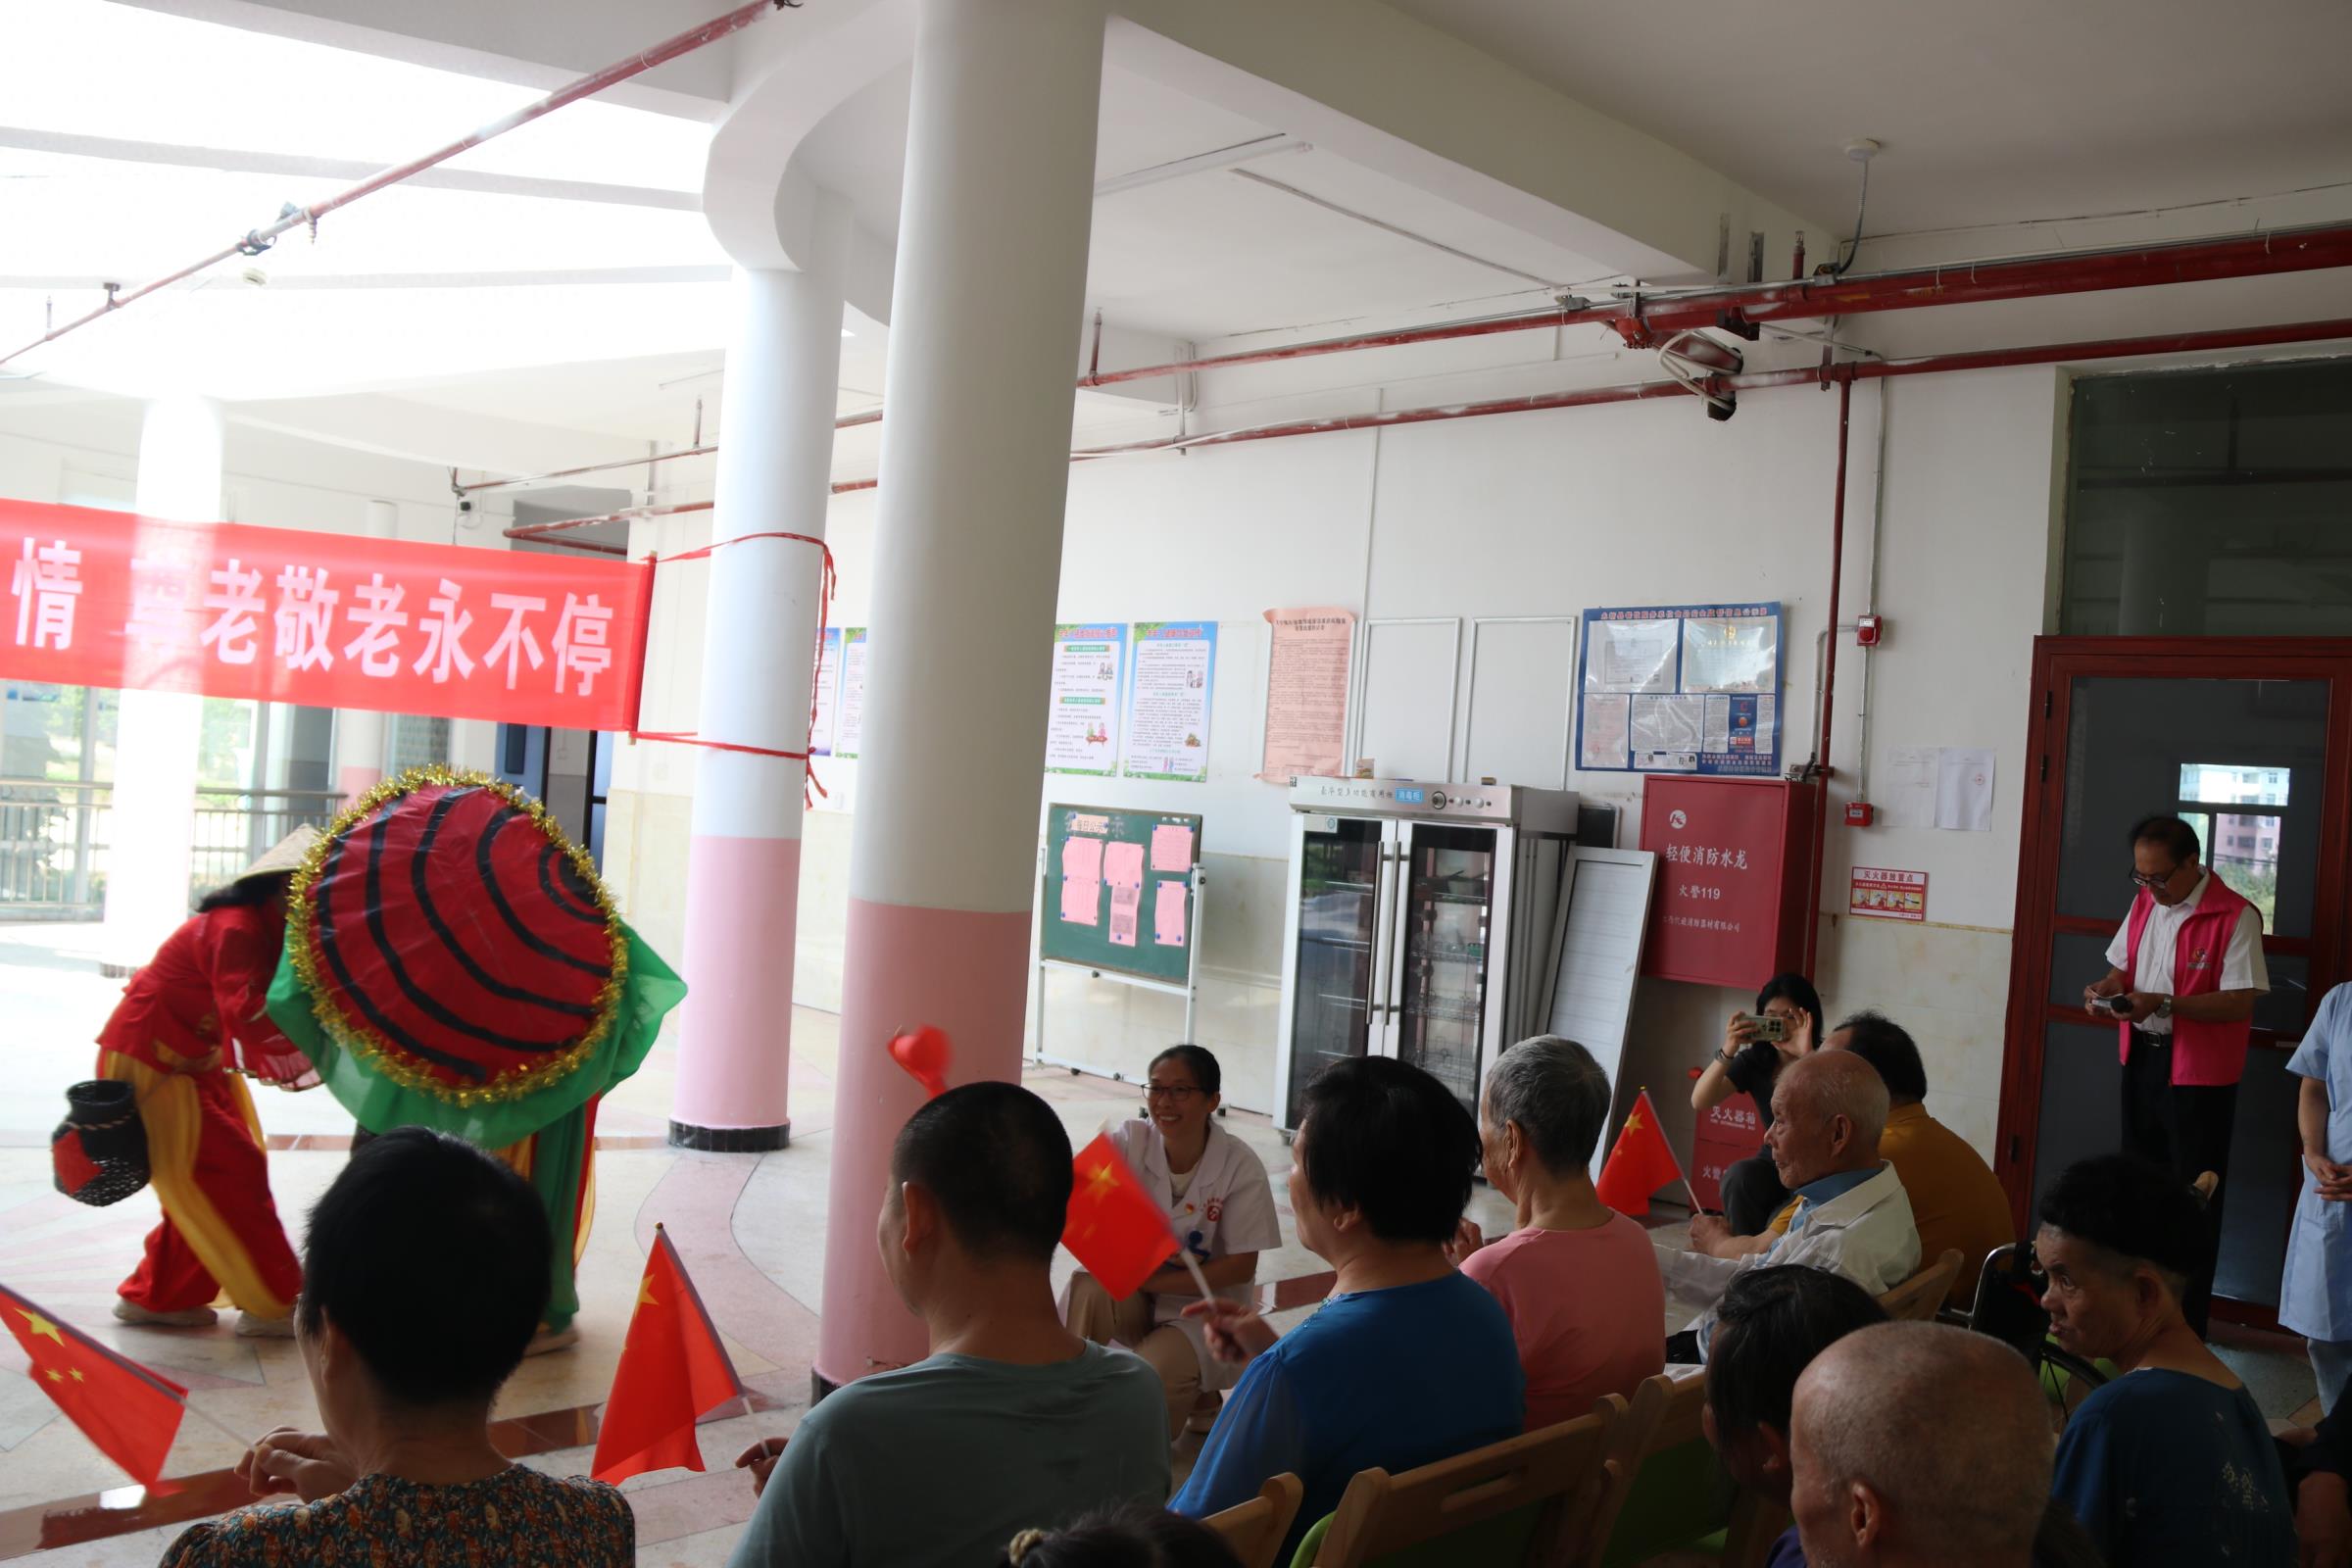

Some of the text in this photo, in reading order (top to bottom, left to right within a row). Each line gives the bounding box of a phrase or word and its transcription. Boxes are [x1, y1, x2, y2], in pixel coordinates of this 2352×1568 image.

[12, 537, 84, 651] 情
[1664, 844, 1748, 870] 轻便消防水龙
[1864, 871, 1914, 883] 灭火器放置点
[1678, 884, 1721, 901] 火警119
[1710, 1105, 1756, 1124] 灭火器箱
